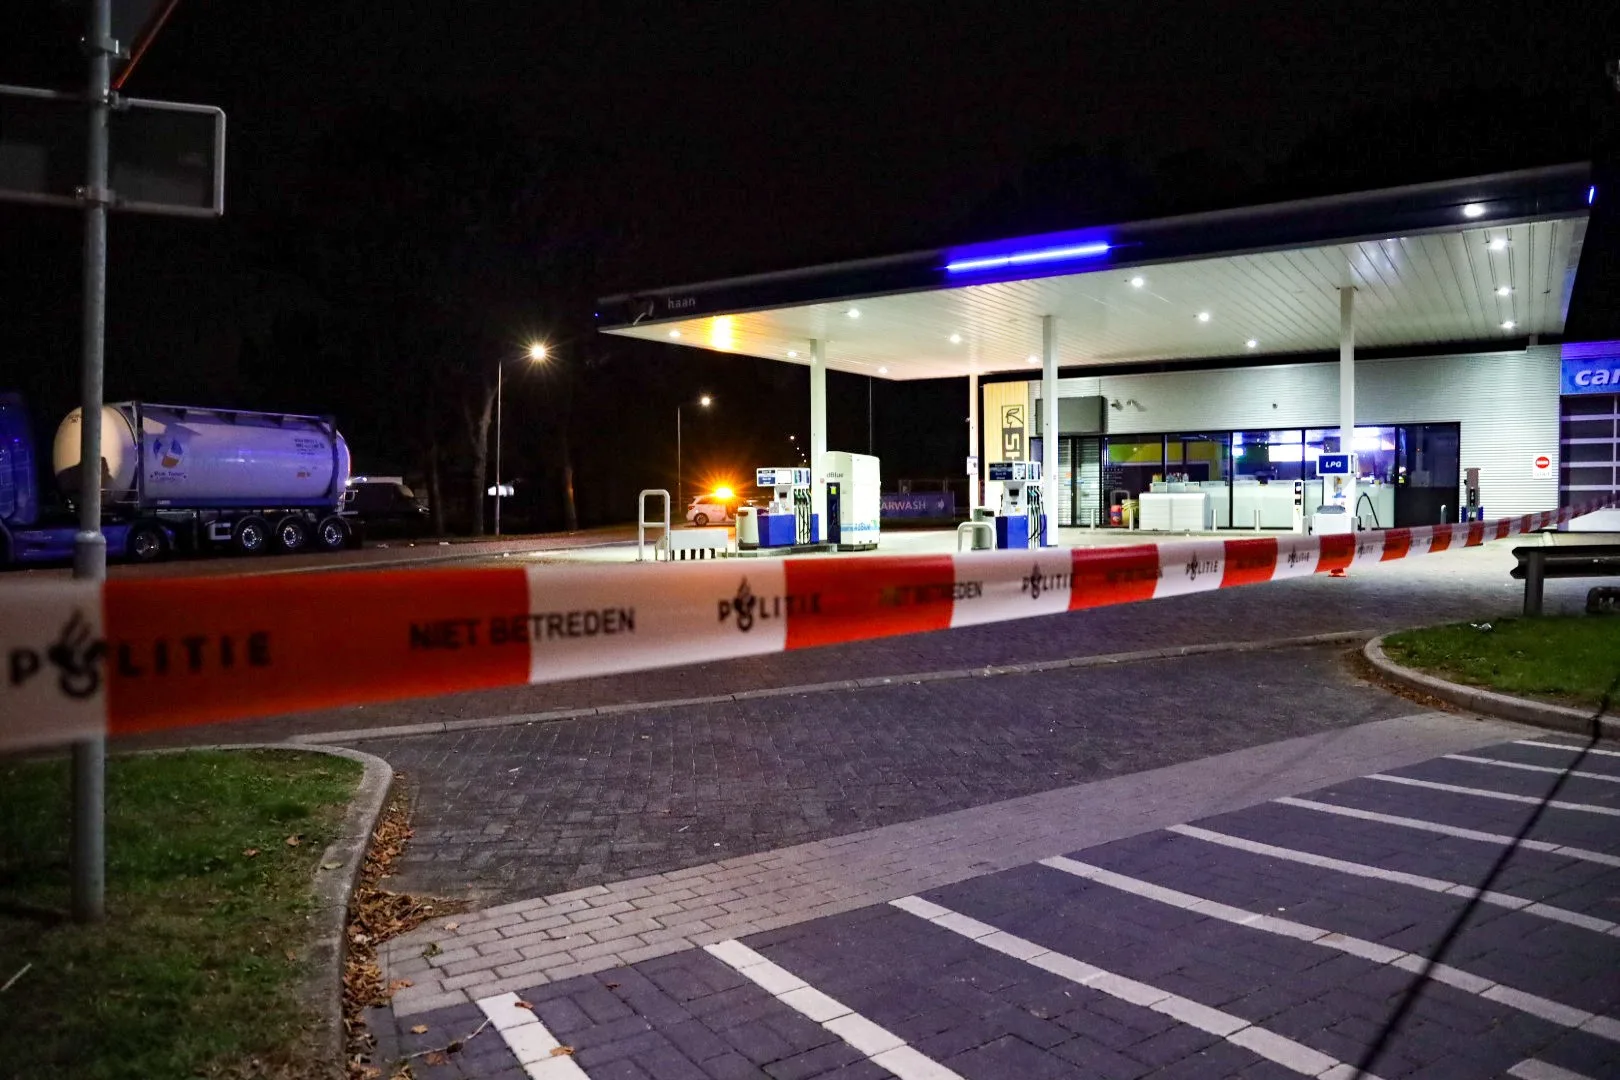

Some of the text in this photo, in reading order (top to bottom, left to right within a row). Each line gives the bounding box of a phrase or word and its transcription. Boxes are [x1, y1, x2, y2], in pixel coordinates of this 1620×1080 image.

[667, 296, 697, 309] haan
[1575, 368, 1620, 386] car
[881, 500, 926, 510] ARWASH
[717, 580, 822, 632] POLITIE
[409, 607, 635, 649] NIET BETREDEN
[9, 612, 273, 699] POLITIE
